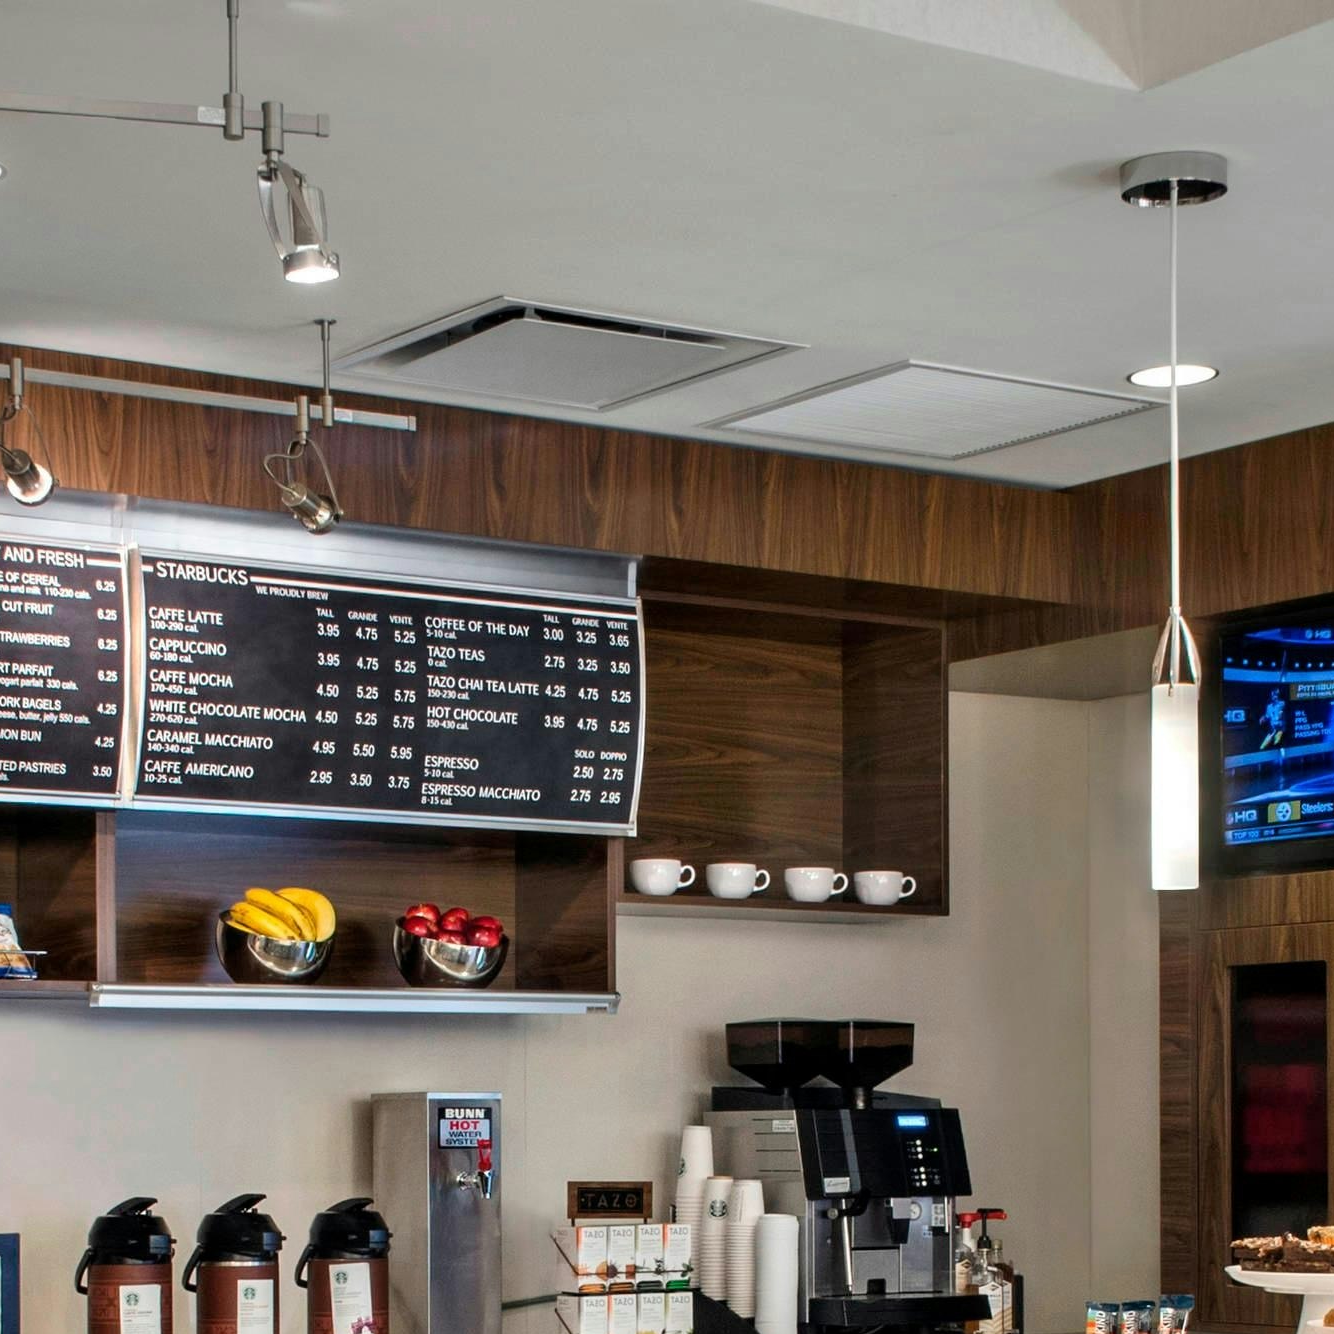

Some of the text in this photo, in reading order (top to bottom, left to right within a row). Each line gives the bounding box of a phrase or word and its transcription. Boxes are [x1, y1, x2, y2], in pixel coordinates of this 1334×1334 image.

[3, 545, 34, 564] AND
[37, 549, 85, 569] FRESH
[156, 562, 248, 586] STARBUCKS
[2, 600, 23, 614] CUT
[24, 601, 54, 616] FRUIT
[149, 606, 224, 626] CAFFE LATTE
[424, 615, 564, 642] COFFEE OF THE DAY 3.00
[149, 636, 379, 671] CAPPUCCINO 3.95 4.75
[427, 645, 565, 669] TAZO TEAS 2.75
[12, 662, 54, 677] PARFAIT
[150, 668, 234, 688] CAFFE MOCHA
[427, 674, 540, 696] TAZO CHAI TEA LATTE
[149, 698, 307, 724] WHITE CHOCOLATE MOCHA
[427, 705, 518, 725] HOT CHOCOLATE
[21, 729, 42, 742] BUN
[95, 736, 115, 748] 4.25
[147, 728, 273, 750] CARAMEL MACCHIATO
[19, 760, 67, 775] PASTRIES
[92, 765, 112, 778] 3.50
[424, 755, 479, 770] ESPRESSO
[144, 759, 372, 787] CAFFE AMERICANO 2.95 3.50
[421, 782, 541, 802] ESPRESSO MACCHIATO
[1234, 809, 1258, 824] HQ
[1301, 802, 1334, 816] Steelers:
[445, 1108, 485, 1119] BUNN
[449, 1120, 480, 1130] HOT
[583, 1192, 638, 1208] TAZO
[584, 1230, 605, 1239] TAZO
[612, 1228, 634, 1237] TAZO
[669, 1227, 689, 1236] TAZO
